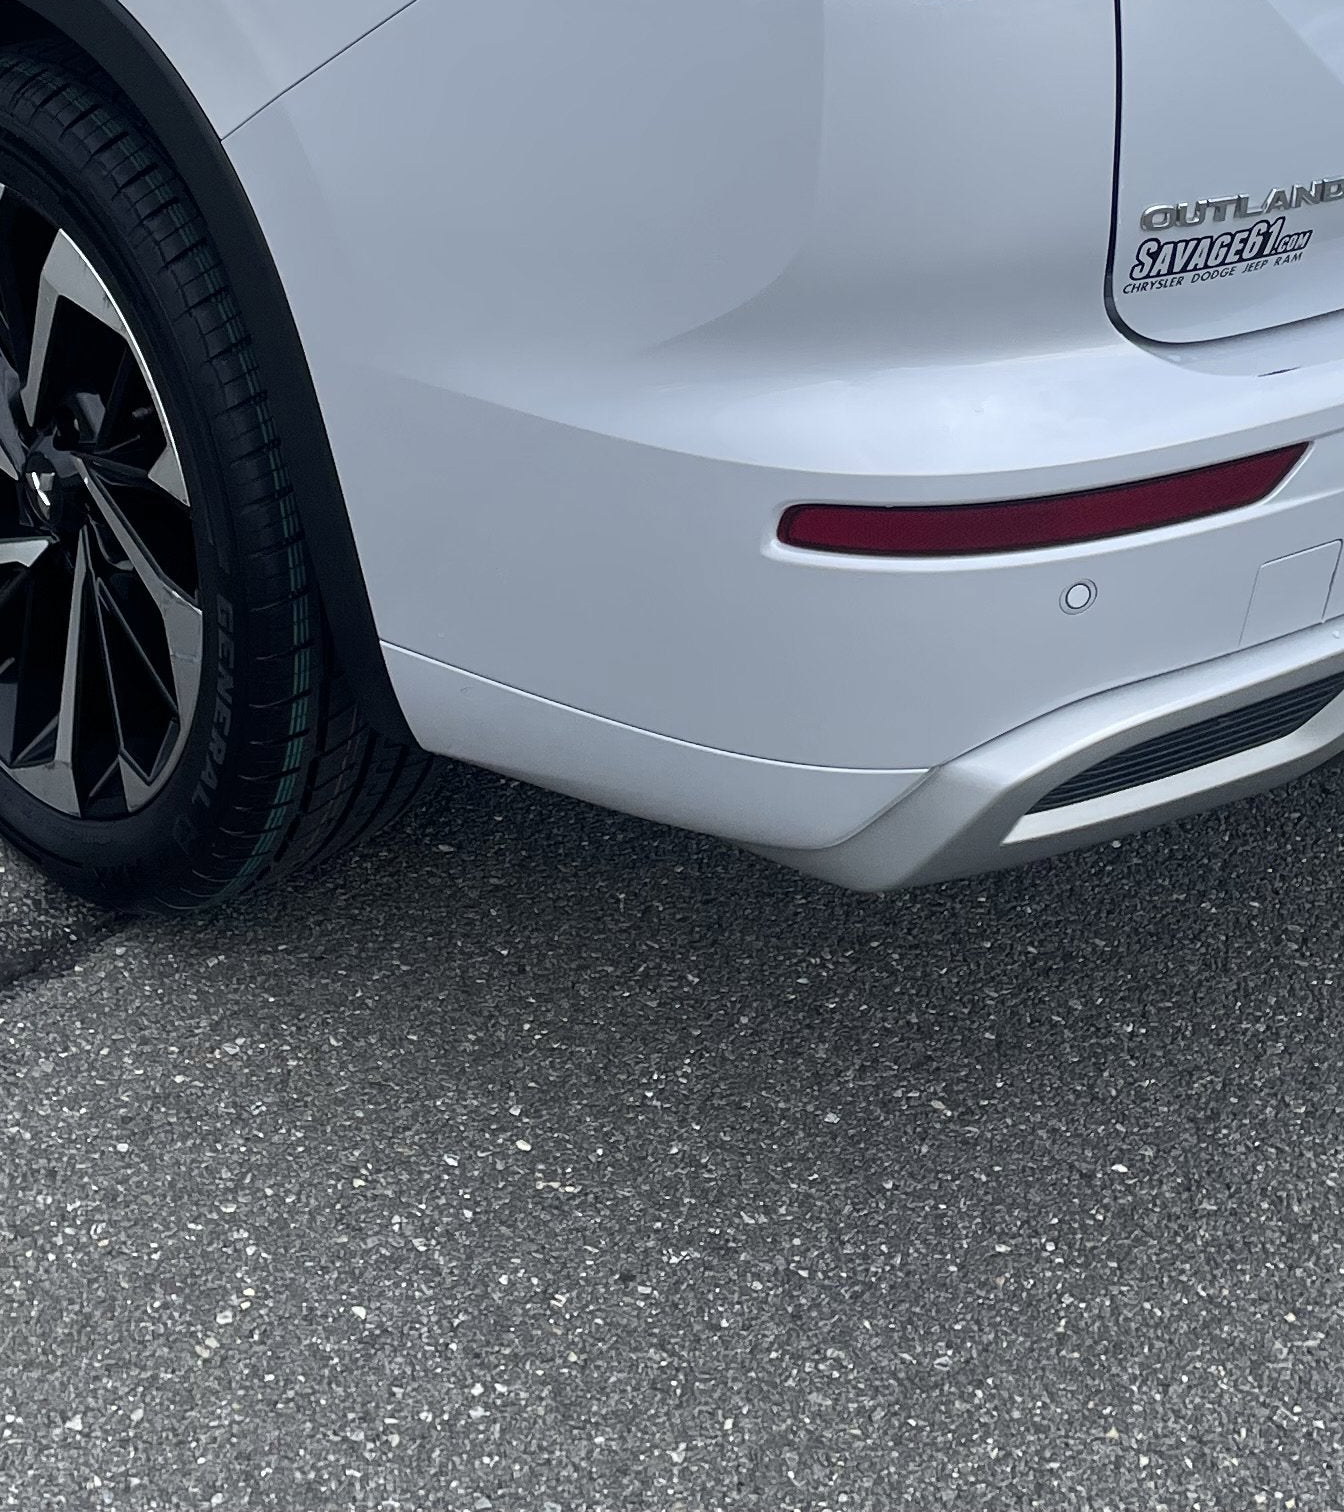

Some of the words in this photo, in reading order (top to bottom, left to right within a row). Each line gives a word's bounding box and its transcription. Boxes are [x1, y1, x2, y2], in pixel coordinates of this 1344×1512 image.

[1122, 276, 1185, 295] CHRYSLER
[1190, 266, 1236, 284] DODGE
[1242, 259, 1269, 275] JEEP
[1274, 252, 1304, 269] RAM
[191, 591, 235, 810] GENERAL
